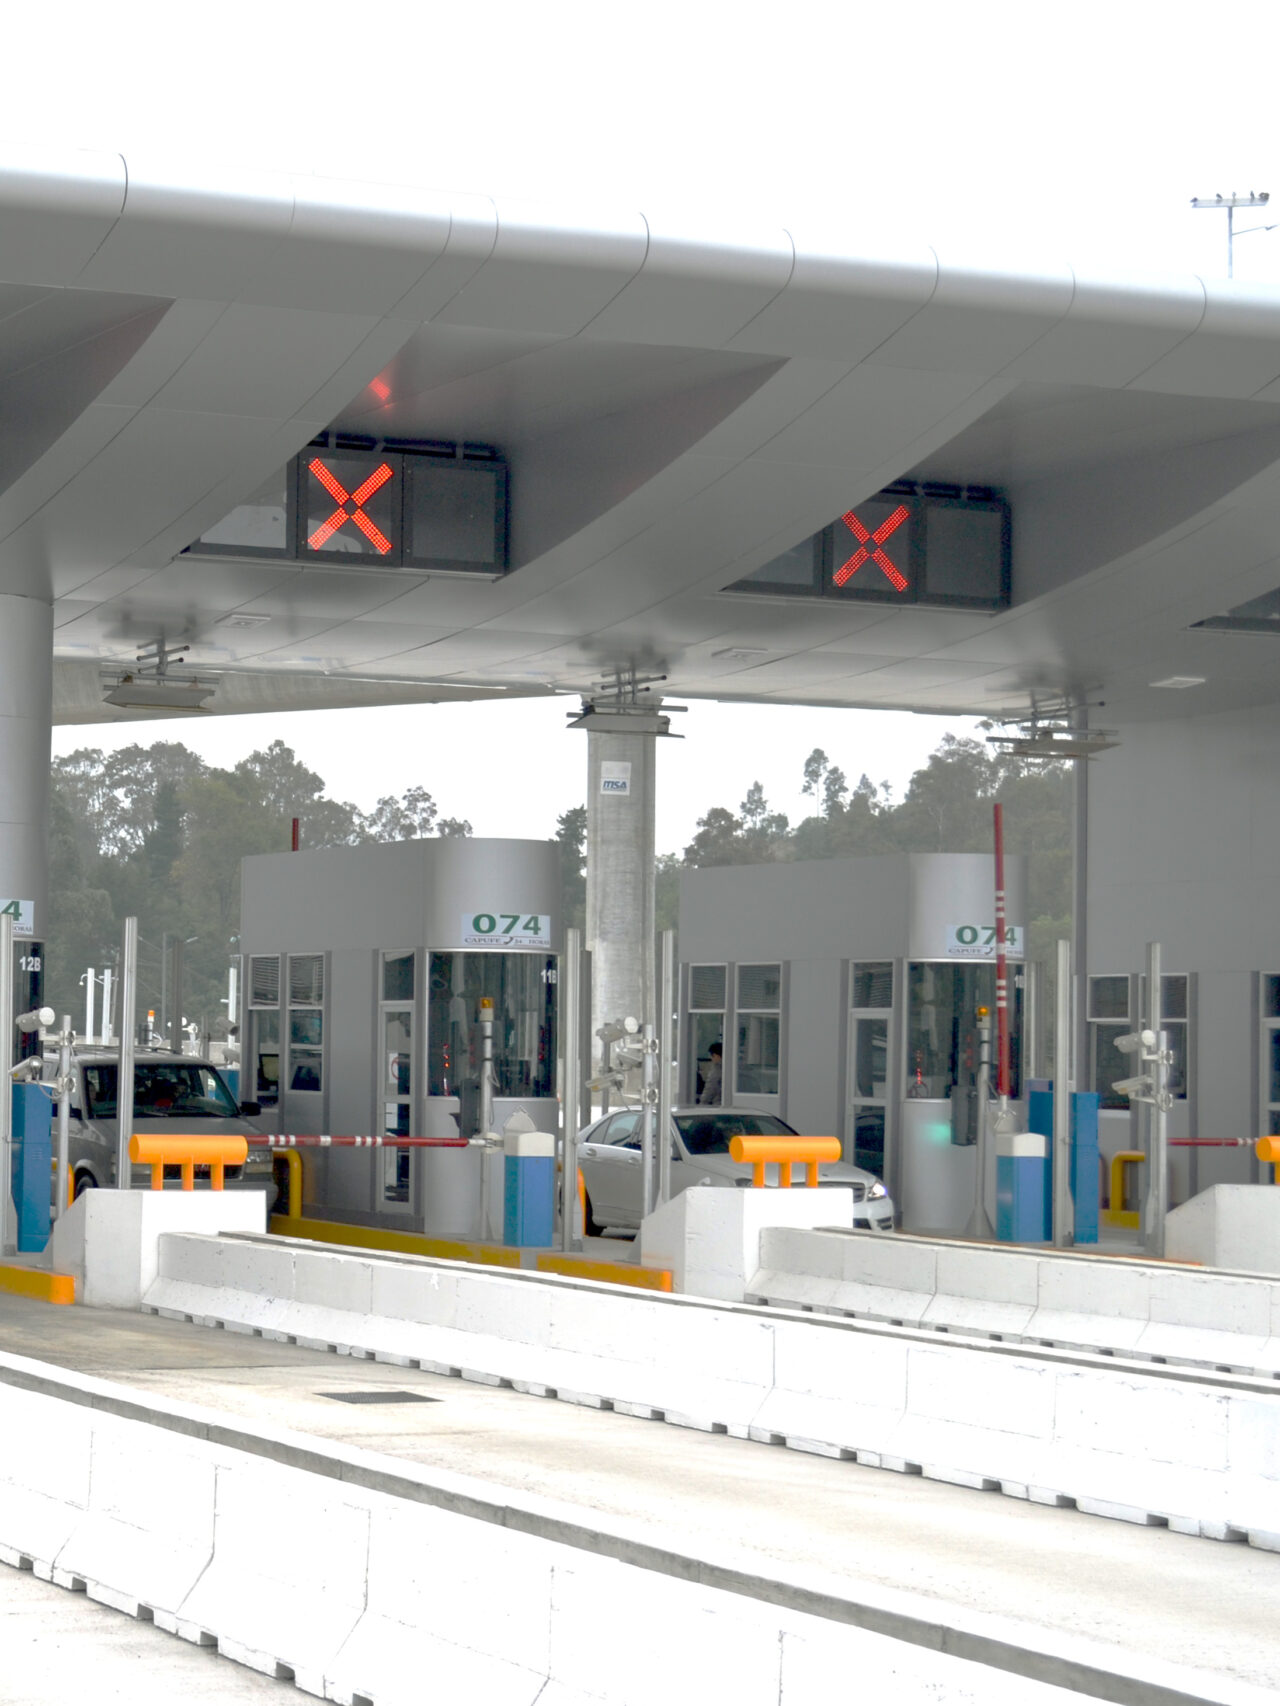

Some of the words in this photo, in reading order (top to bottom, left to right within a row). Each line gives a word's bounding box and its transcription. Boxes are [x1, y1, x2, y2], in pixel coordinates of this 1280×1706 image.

[472, 913, 541, 936] 074
[956, 925, 1017, 947] 074
[20, 956, 41, 972] 12B
